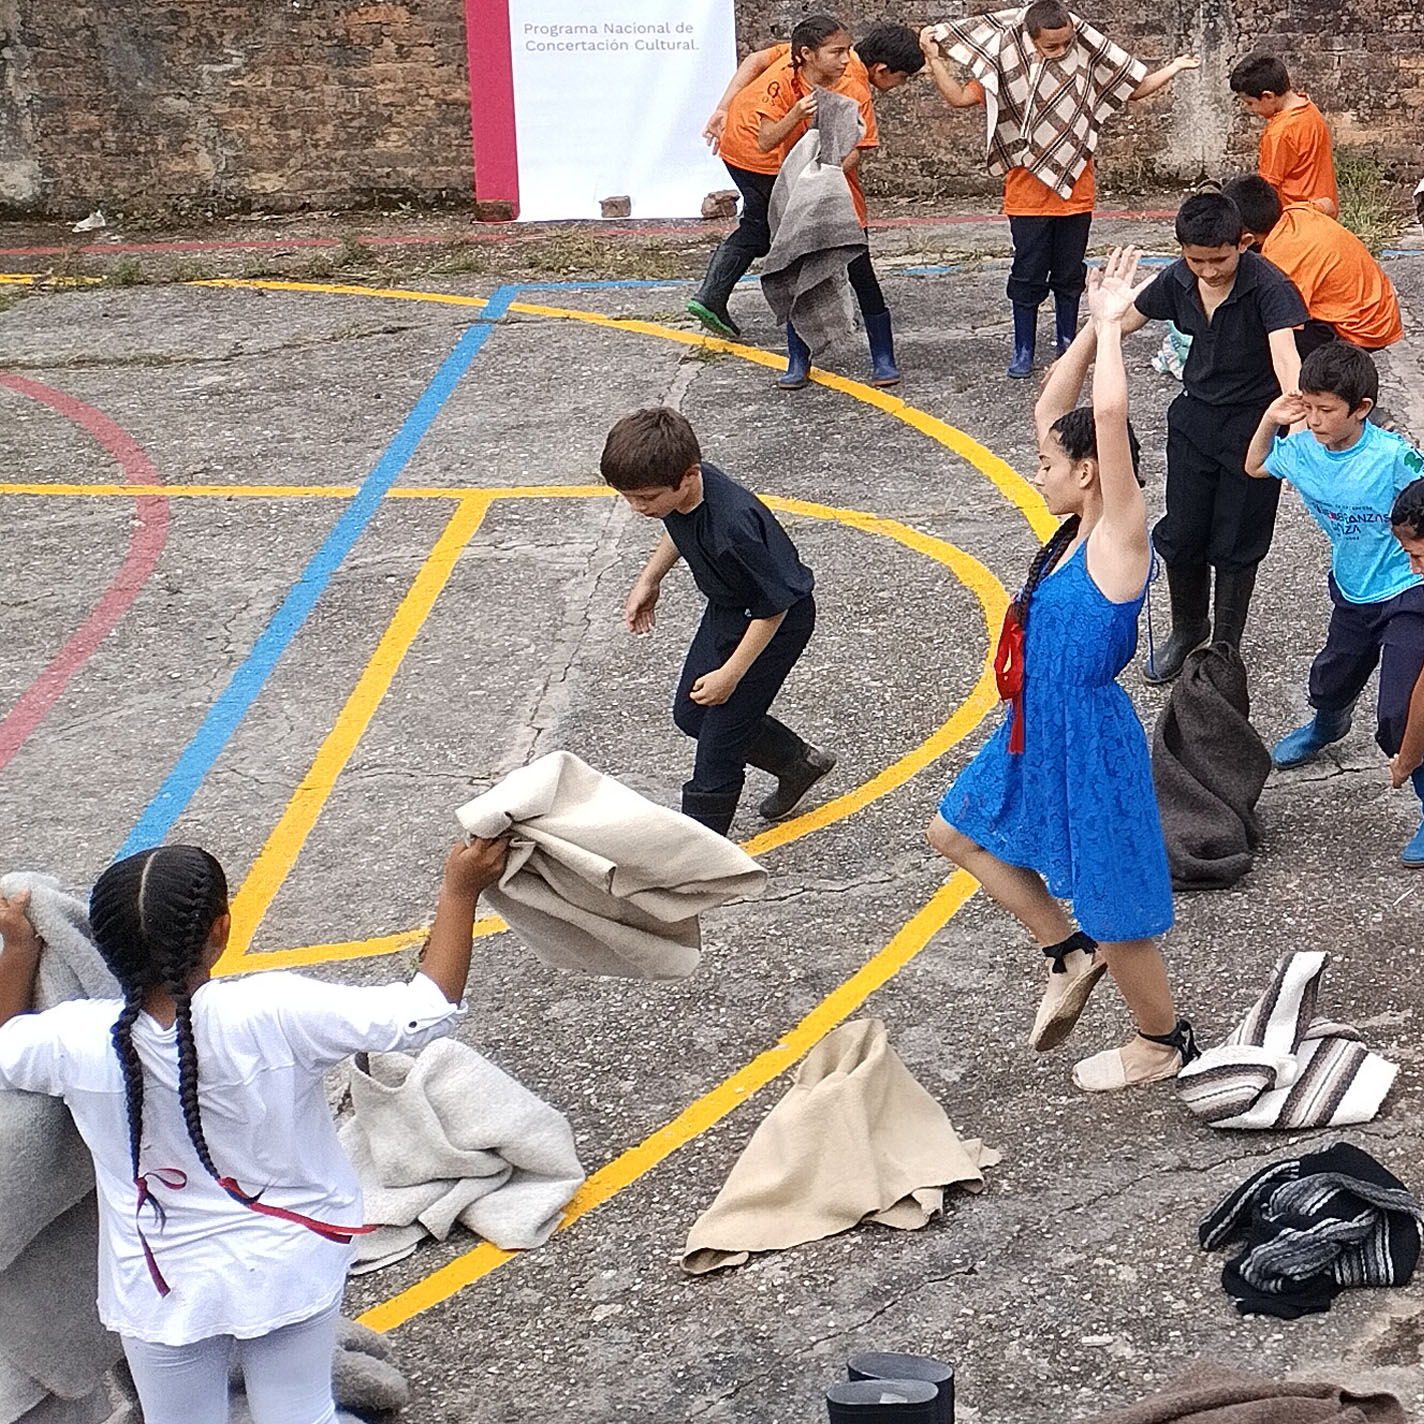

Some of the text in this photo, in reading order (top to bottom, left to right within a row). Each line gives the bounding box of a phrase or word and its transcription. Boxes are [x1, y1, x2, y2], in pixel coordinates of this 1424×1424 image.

[523, 22, 694, 37] Programa Nacional de
[525, 38, 700, 51] Concertación Cultural.
